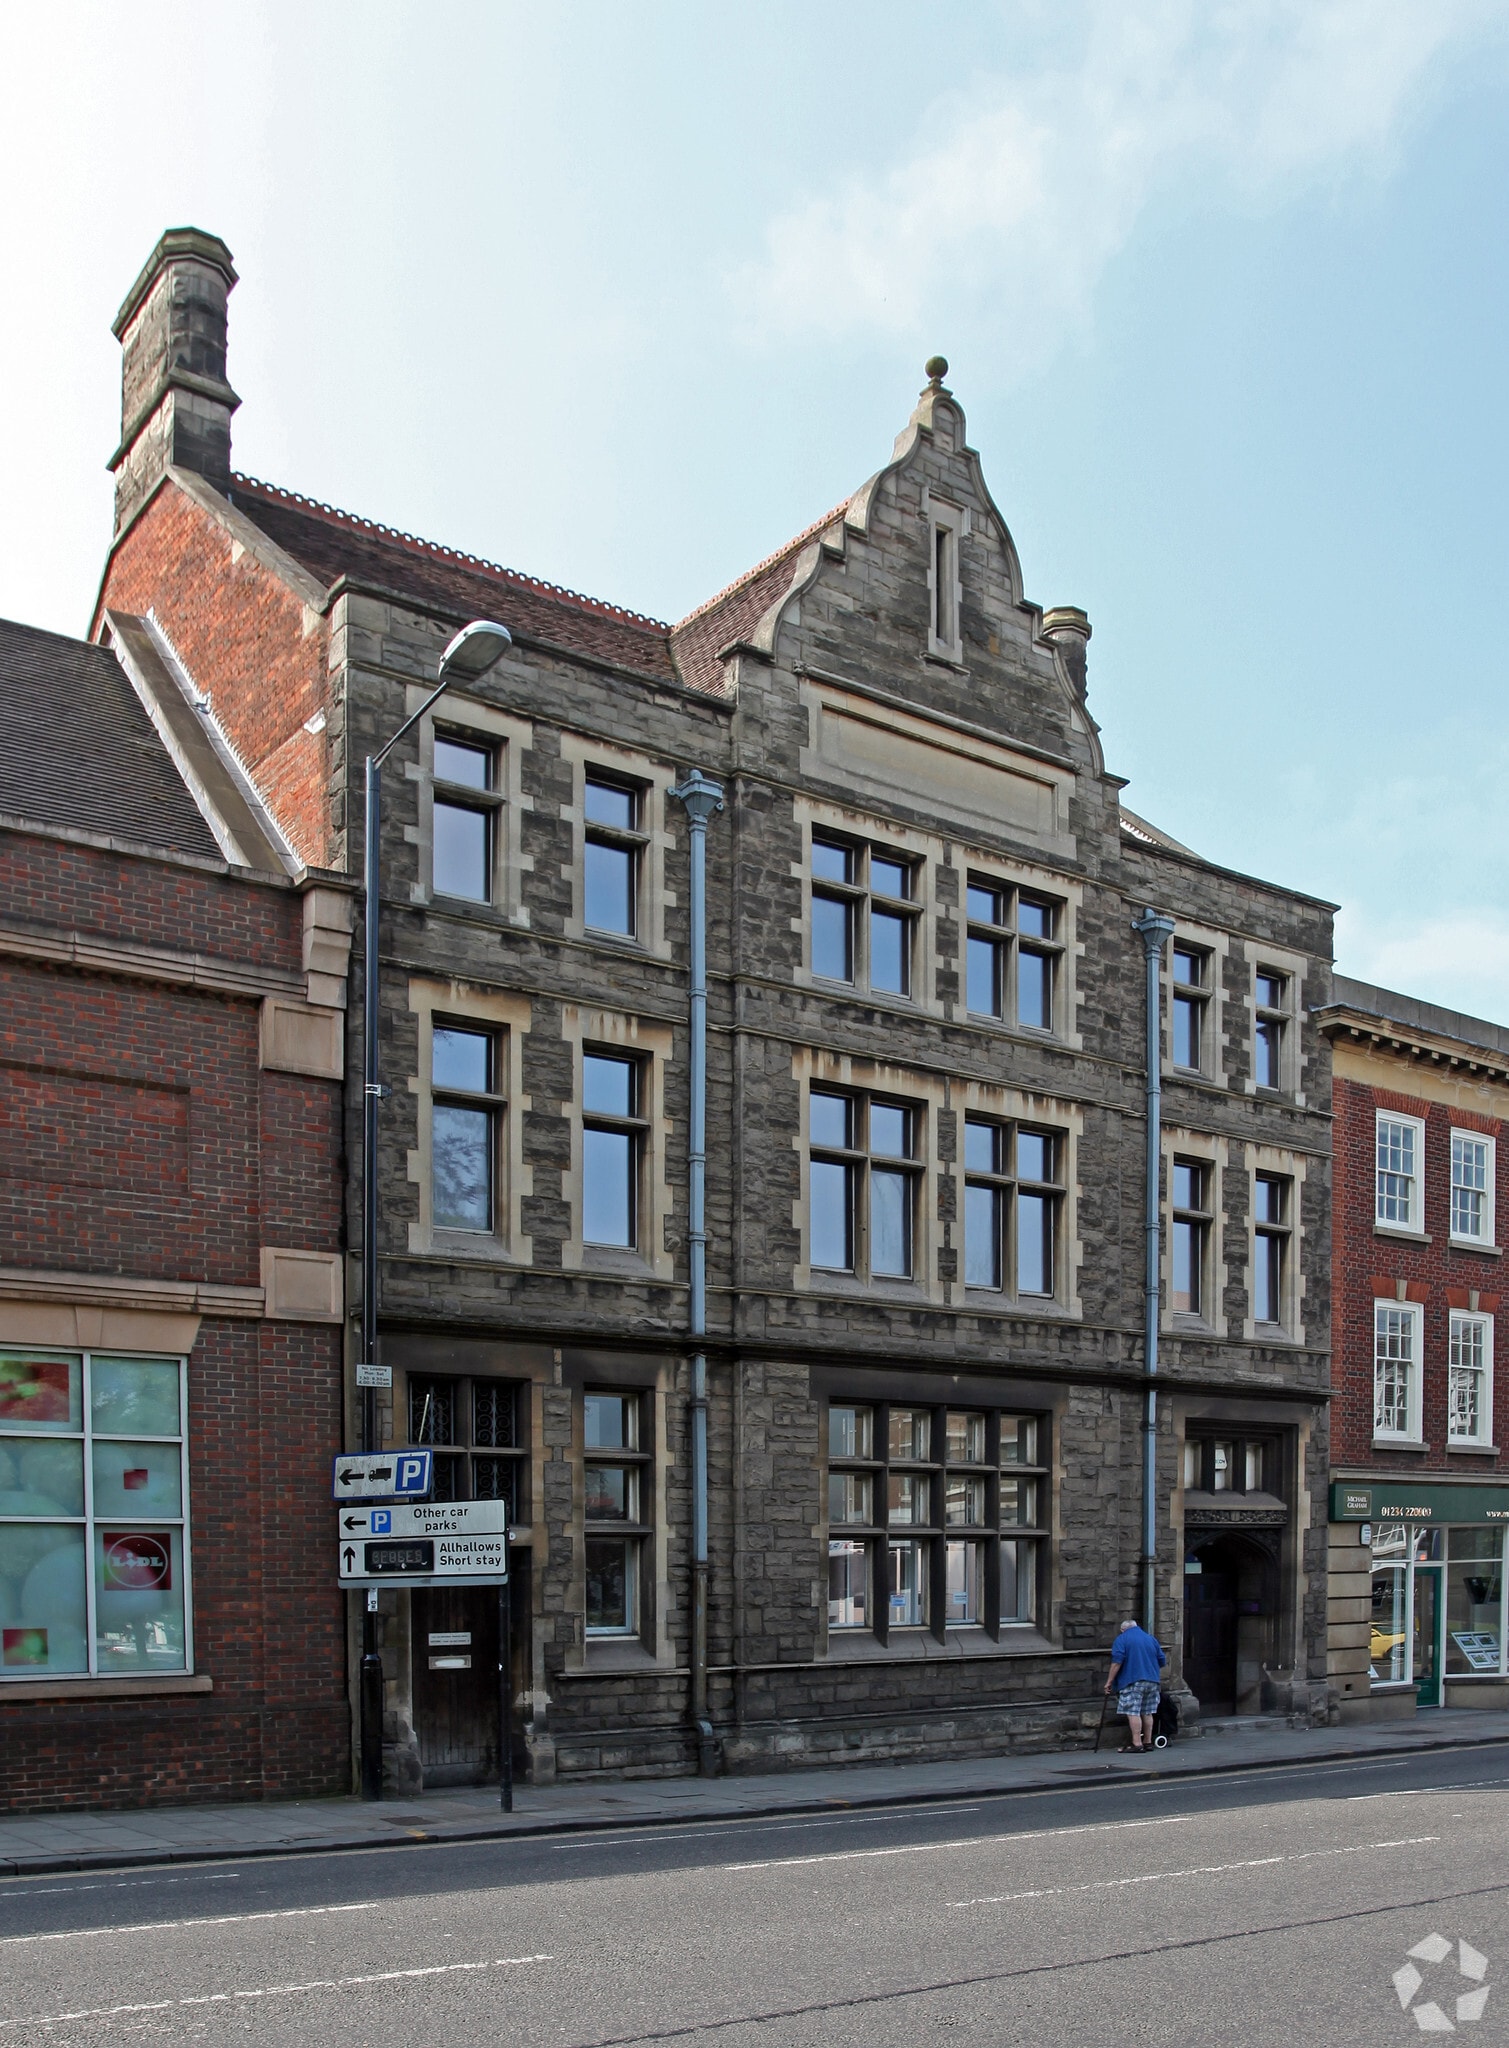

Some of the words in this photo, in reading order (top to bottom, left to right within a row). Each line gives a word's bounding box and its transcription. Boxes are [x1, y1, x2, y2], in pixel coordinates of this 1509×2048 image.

[401, 1460, 421, 1488] P
[413, 1508, 446, 1519] Other
[450, 1508, 469, 1516] car
[374, 1512, 388, 1532] P
[425, 1520, 457, 1532] parks
[439, 1542, 502, 1553] Allhallows
[439, 1555, 472, 1566] Short
[475, 1555, 502, 1567] stay
